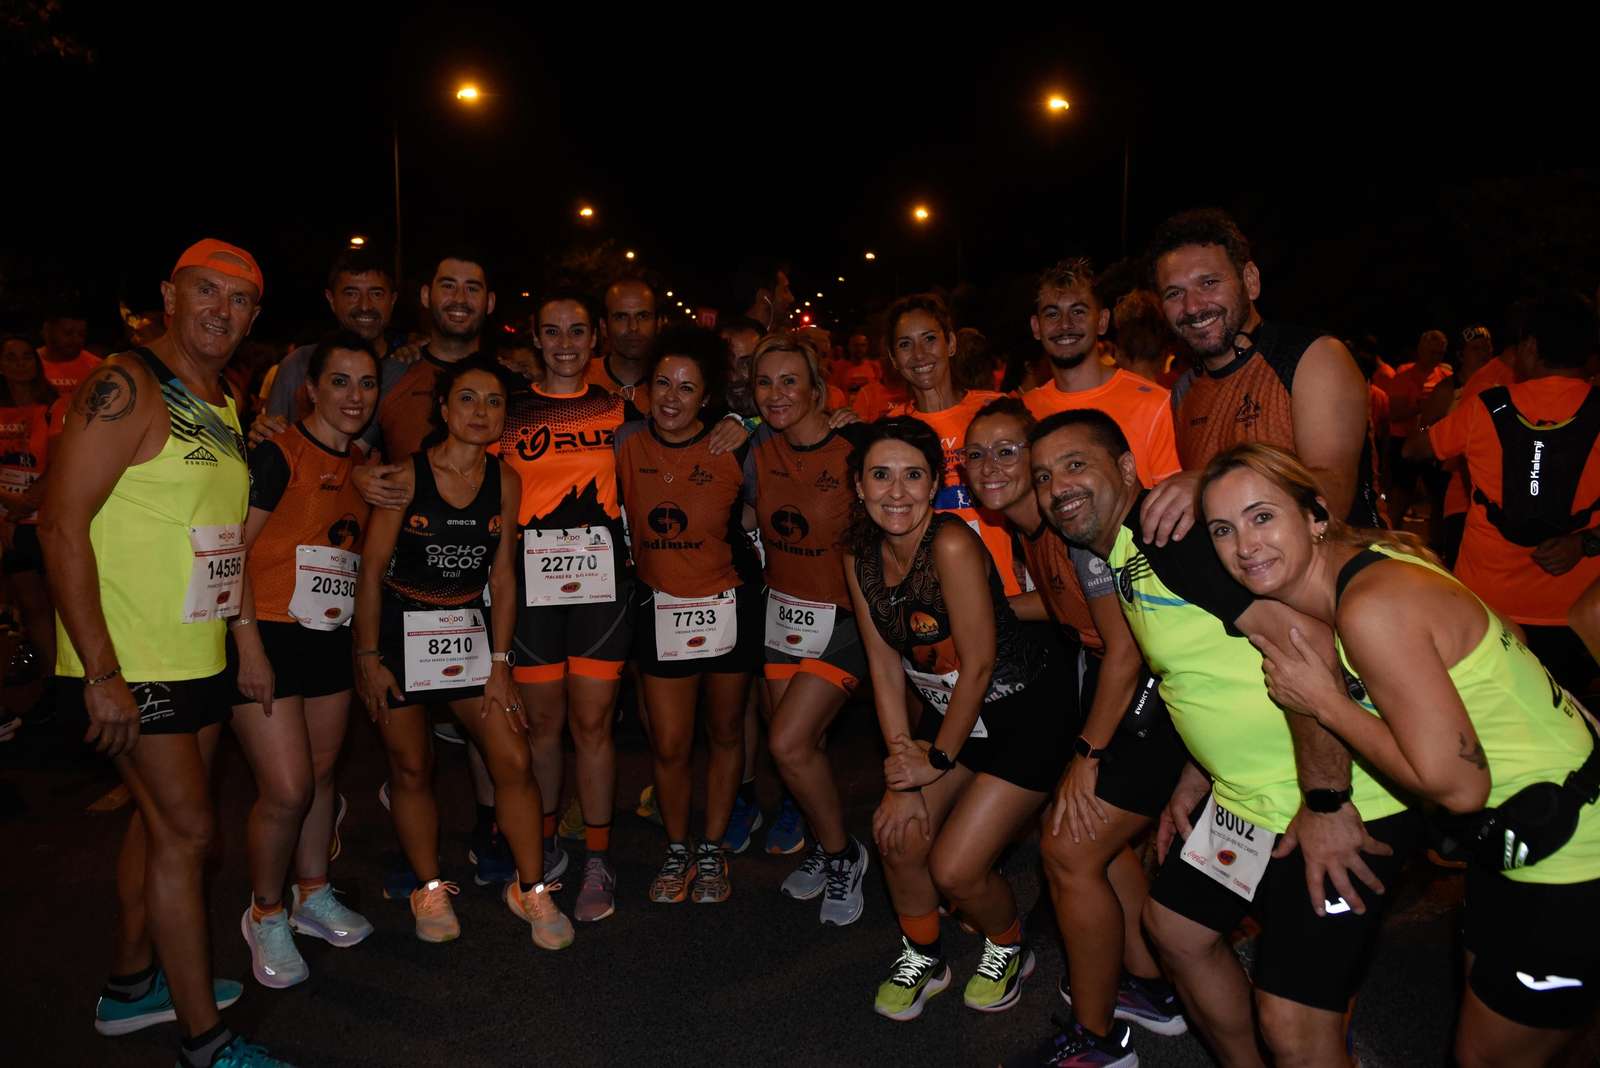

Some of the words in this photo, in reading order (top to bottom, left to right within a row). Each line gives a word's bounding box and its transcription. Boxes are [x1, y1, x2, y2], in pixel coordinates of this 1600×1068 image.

[1530, 440, 1545, 479] Kalenji
[425, 544, 487, 556] OCHO
[642, 539, 703, 550] odimar
[768, 538, 828, 557] odimar
[208, 556, 242, 580] 14556
[427, 554, 483, 570] PICOS
[541, 554, 598, 572] 22770
[442, 570, 462, 578] trail
[312, 576, 356, 598] 20330
[673, 610, 716, 628] 7733
[779, 606, 814, 626] 8426
[428, 637, 472, 654] 8210
[1134, 690, 1150, 716] EVADICT
[1216, 804, 1254, 842] 8002
